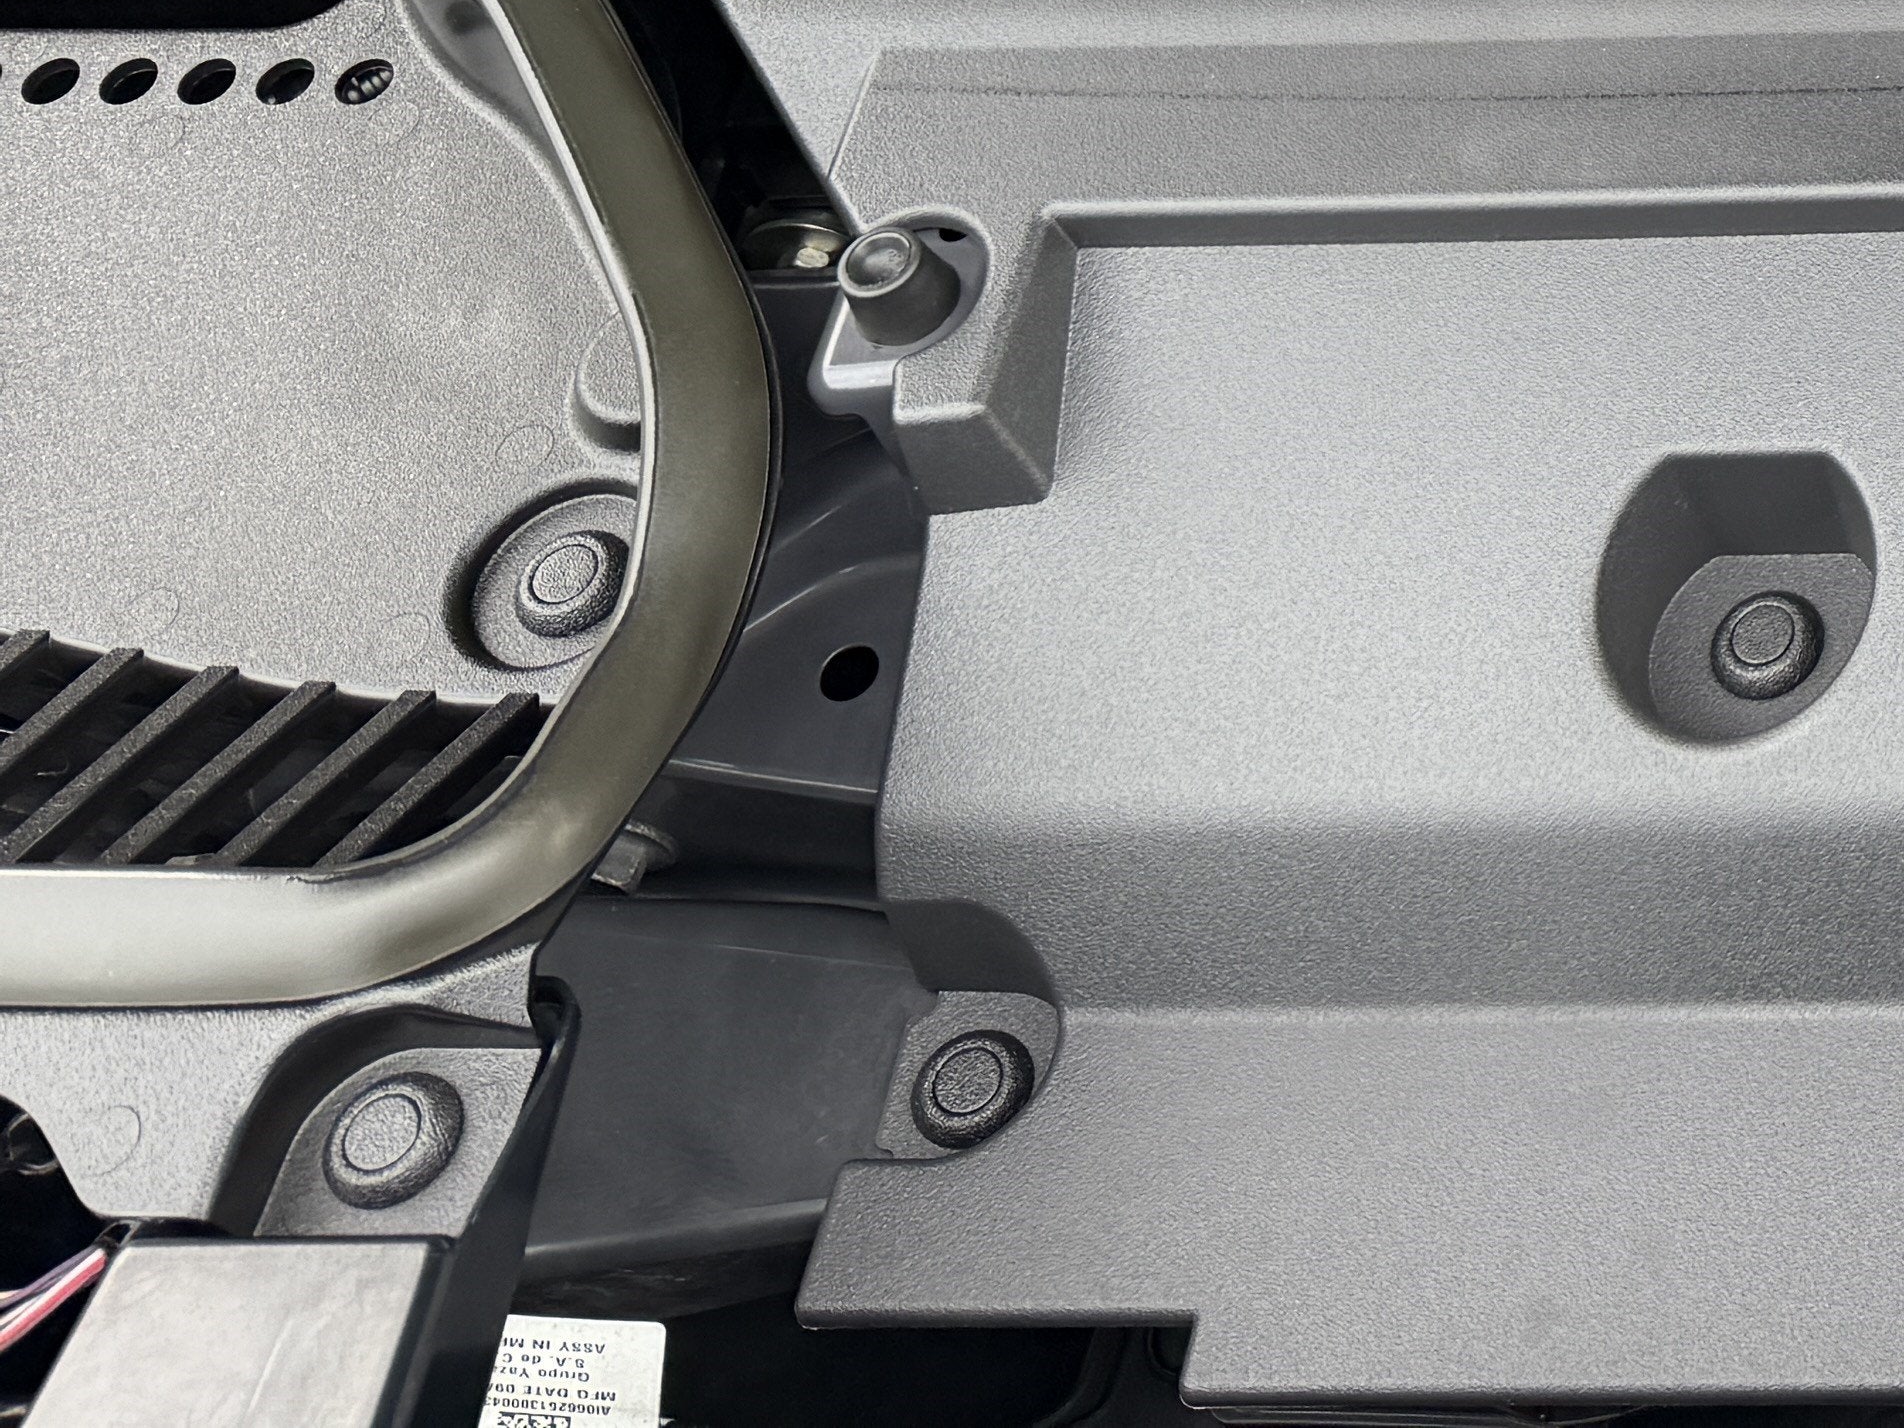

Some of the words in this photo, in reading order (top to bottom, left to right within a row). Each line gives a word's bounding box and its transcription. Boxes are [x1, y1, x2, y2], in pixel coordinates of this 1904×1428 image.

[532, 1339, 552, 1351] IN
[560, 1342, 606, 1354] ASSY
[523, 1385, 569, 1398] DATE
